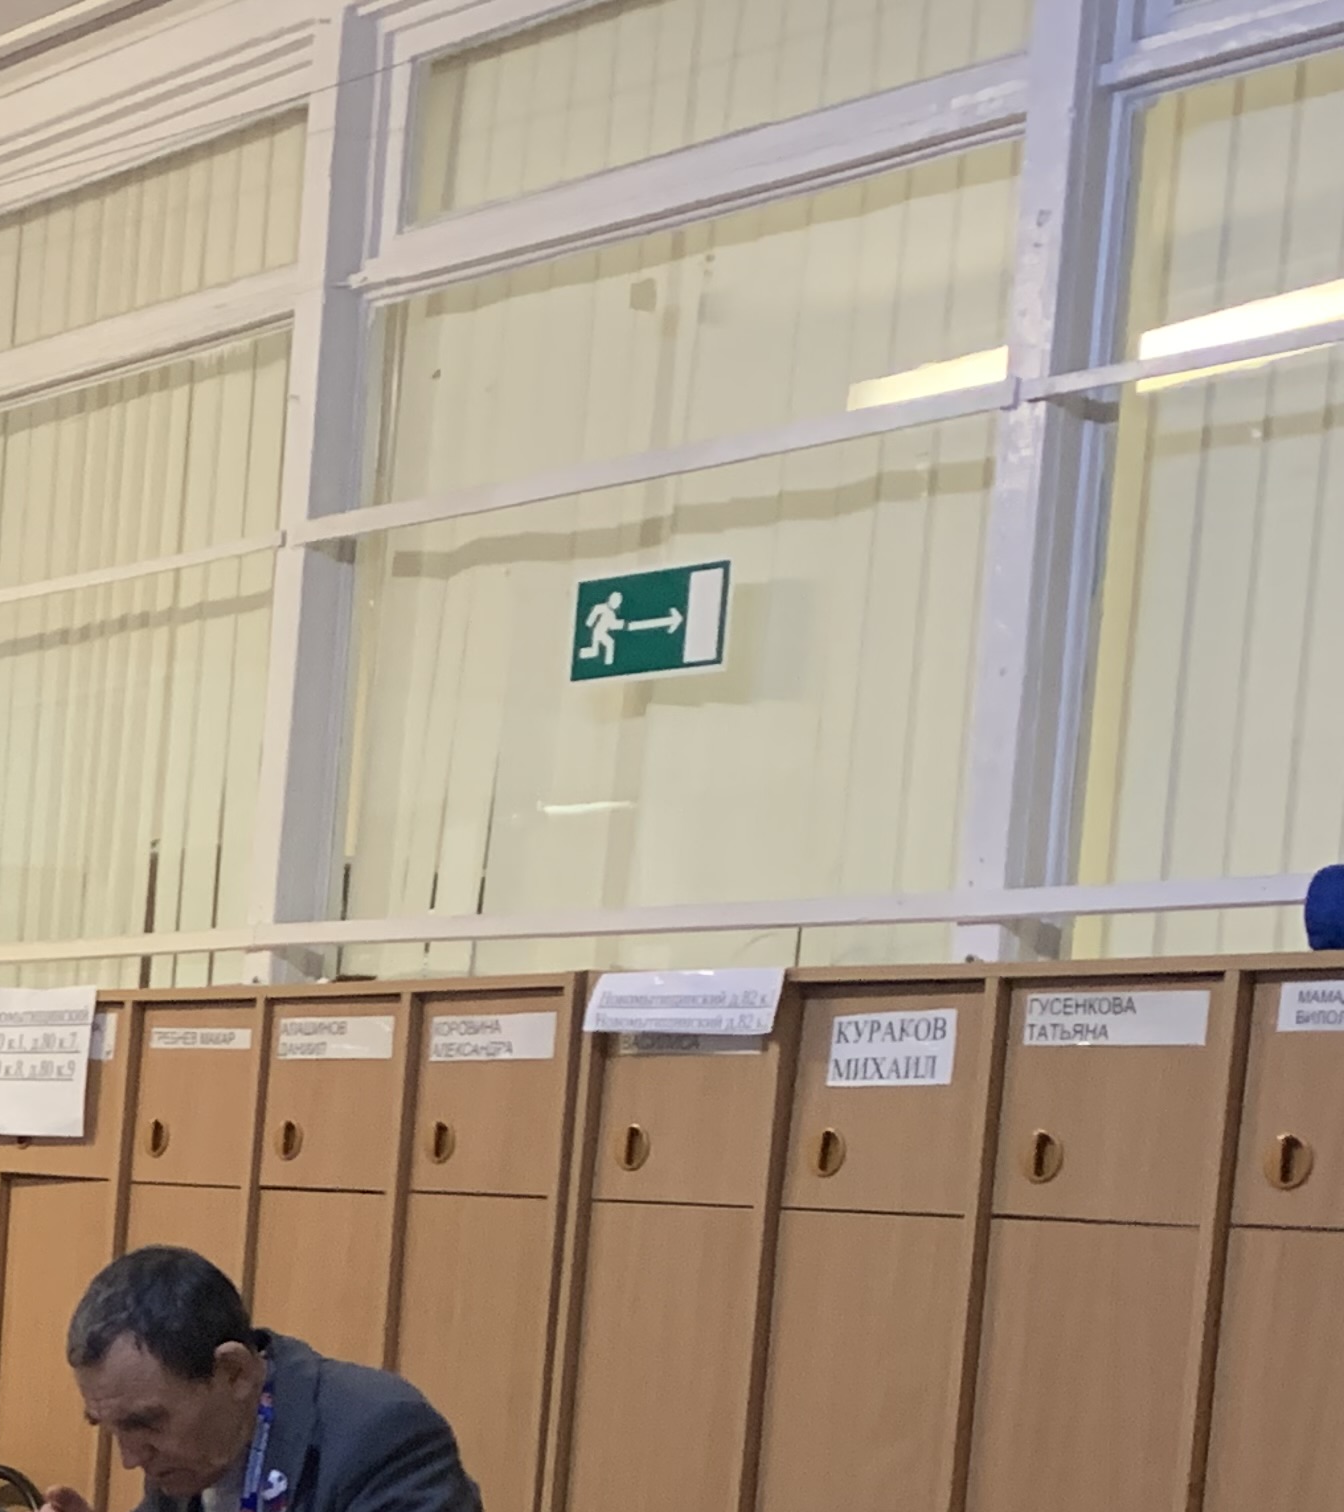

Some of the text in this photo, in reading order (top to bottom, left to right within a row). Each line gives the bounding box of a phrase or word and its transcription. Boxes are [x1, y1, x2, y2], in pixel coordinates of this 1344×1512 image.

[1298, 989, 1344, 1005] МАМА
[1028, 997, 1137, 1016] ГУСЕНКОВА
[835, 1017, 947, 1044] КУРАКОВ
[1027, 1023, 1109, 1041] ТАТЬЯНА
[431, 1040, 514, 1058] АЛЕКСАНДРА
[832, 1055, 937, 1081] МИХАИЛ
